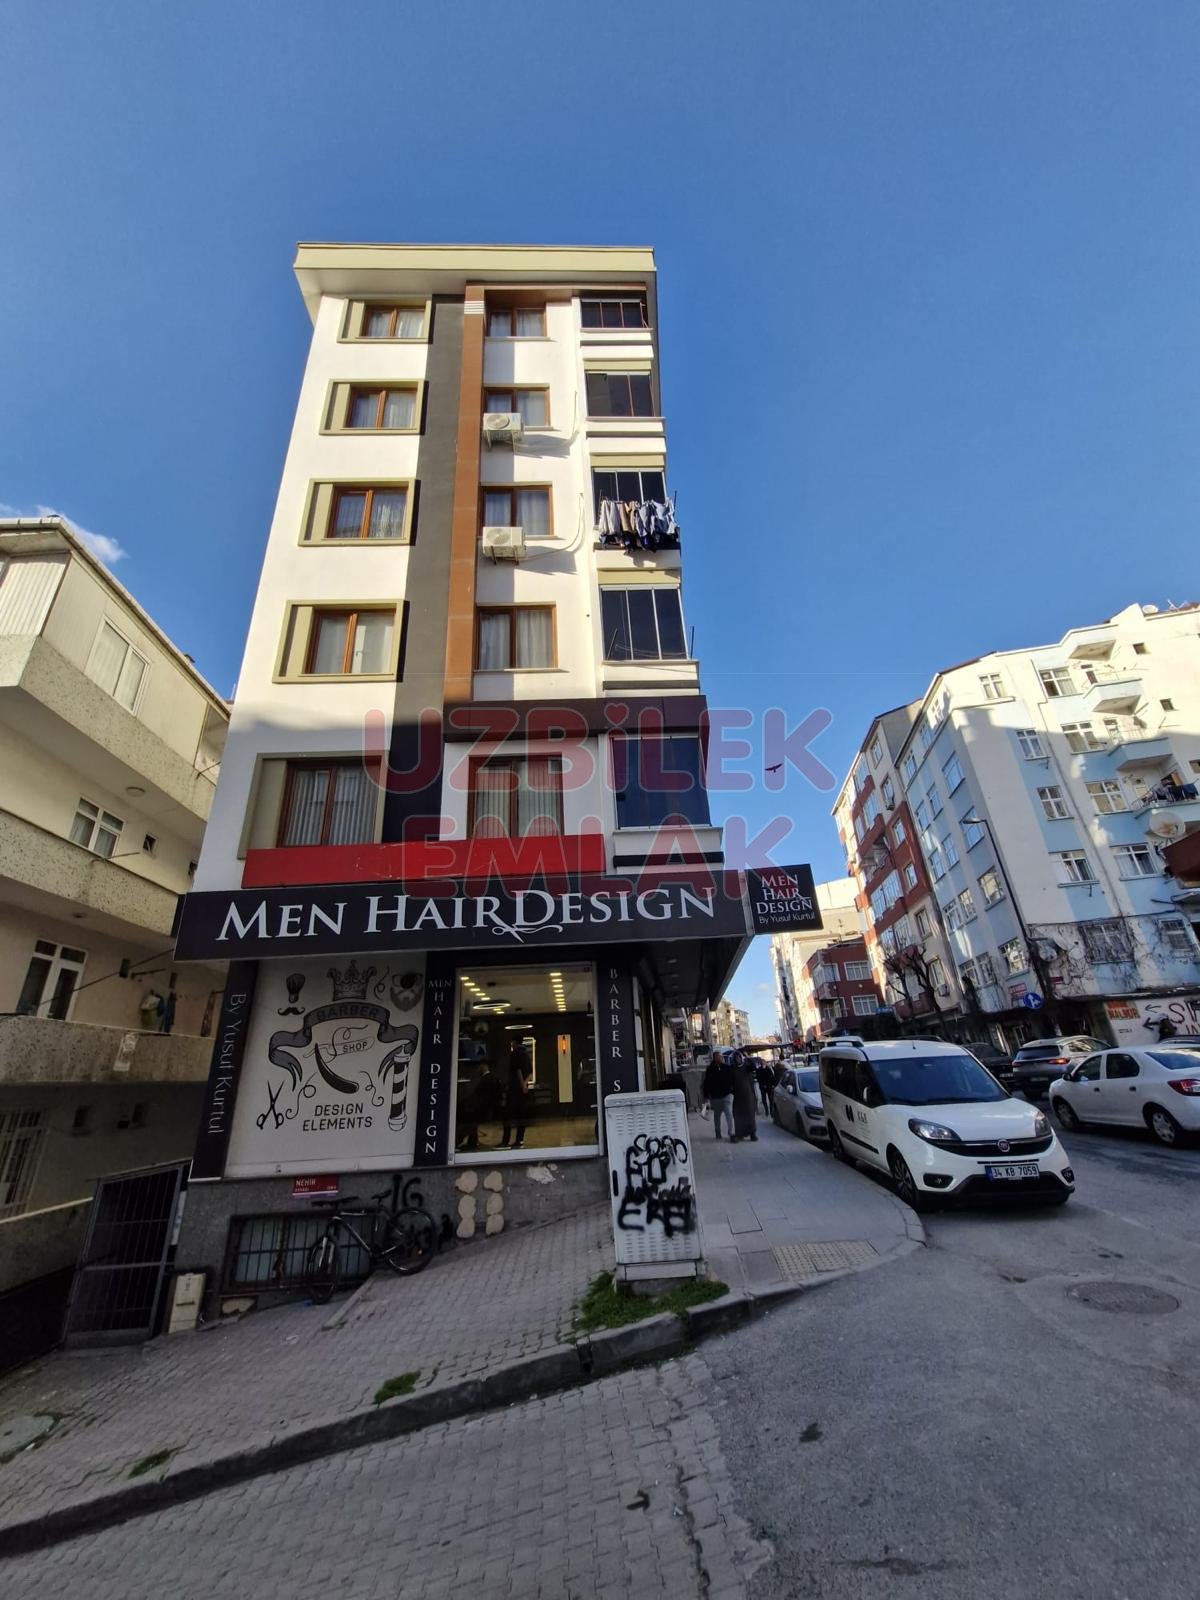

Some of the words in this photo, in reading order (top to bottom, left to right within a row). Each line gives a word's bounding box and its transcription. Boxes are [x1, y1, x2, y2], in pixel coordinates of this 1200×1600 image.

[761, 874, 798, 888] MEN
[762, 887, 801, 901] HAIR
[756, 900, 813, 914] DESIGN
[215, 900, 348, 940] MEN
[428, 979, 452, 988] MEN
[229, 993, 247, 1016] By
[316, 1005, 378, 1019] BARBER
[433, 991, 444, 1044] HAIR
[609, 968, 622, 1058] BARBER
[342, 1041, 368, 1053] SHOP
[314, 1103, 364, 1117] DESIGN
[425, 1063, 441, 1154] DESIGN
[302, 1116, 373, 1132] ELEMENTS
